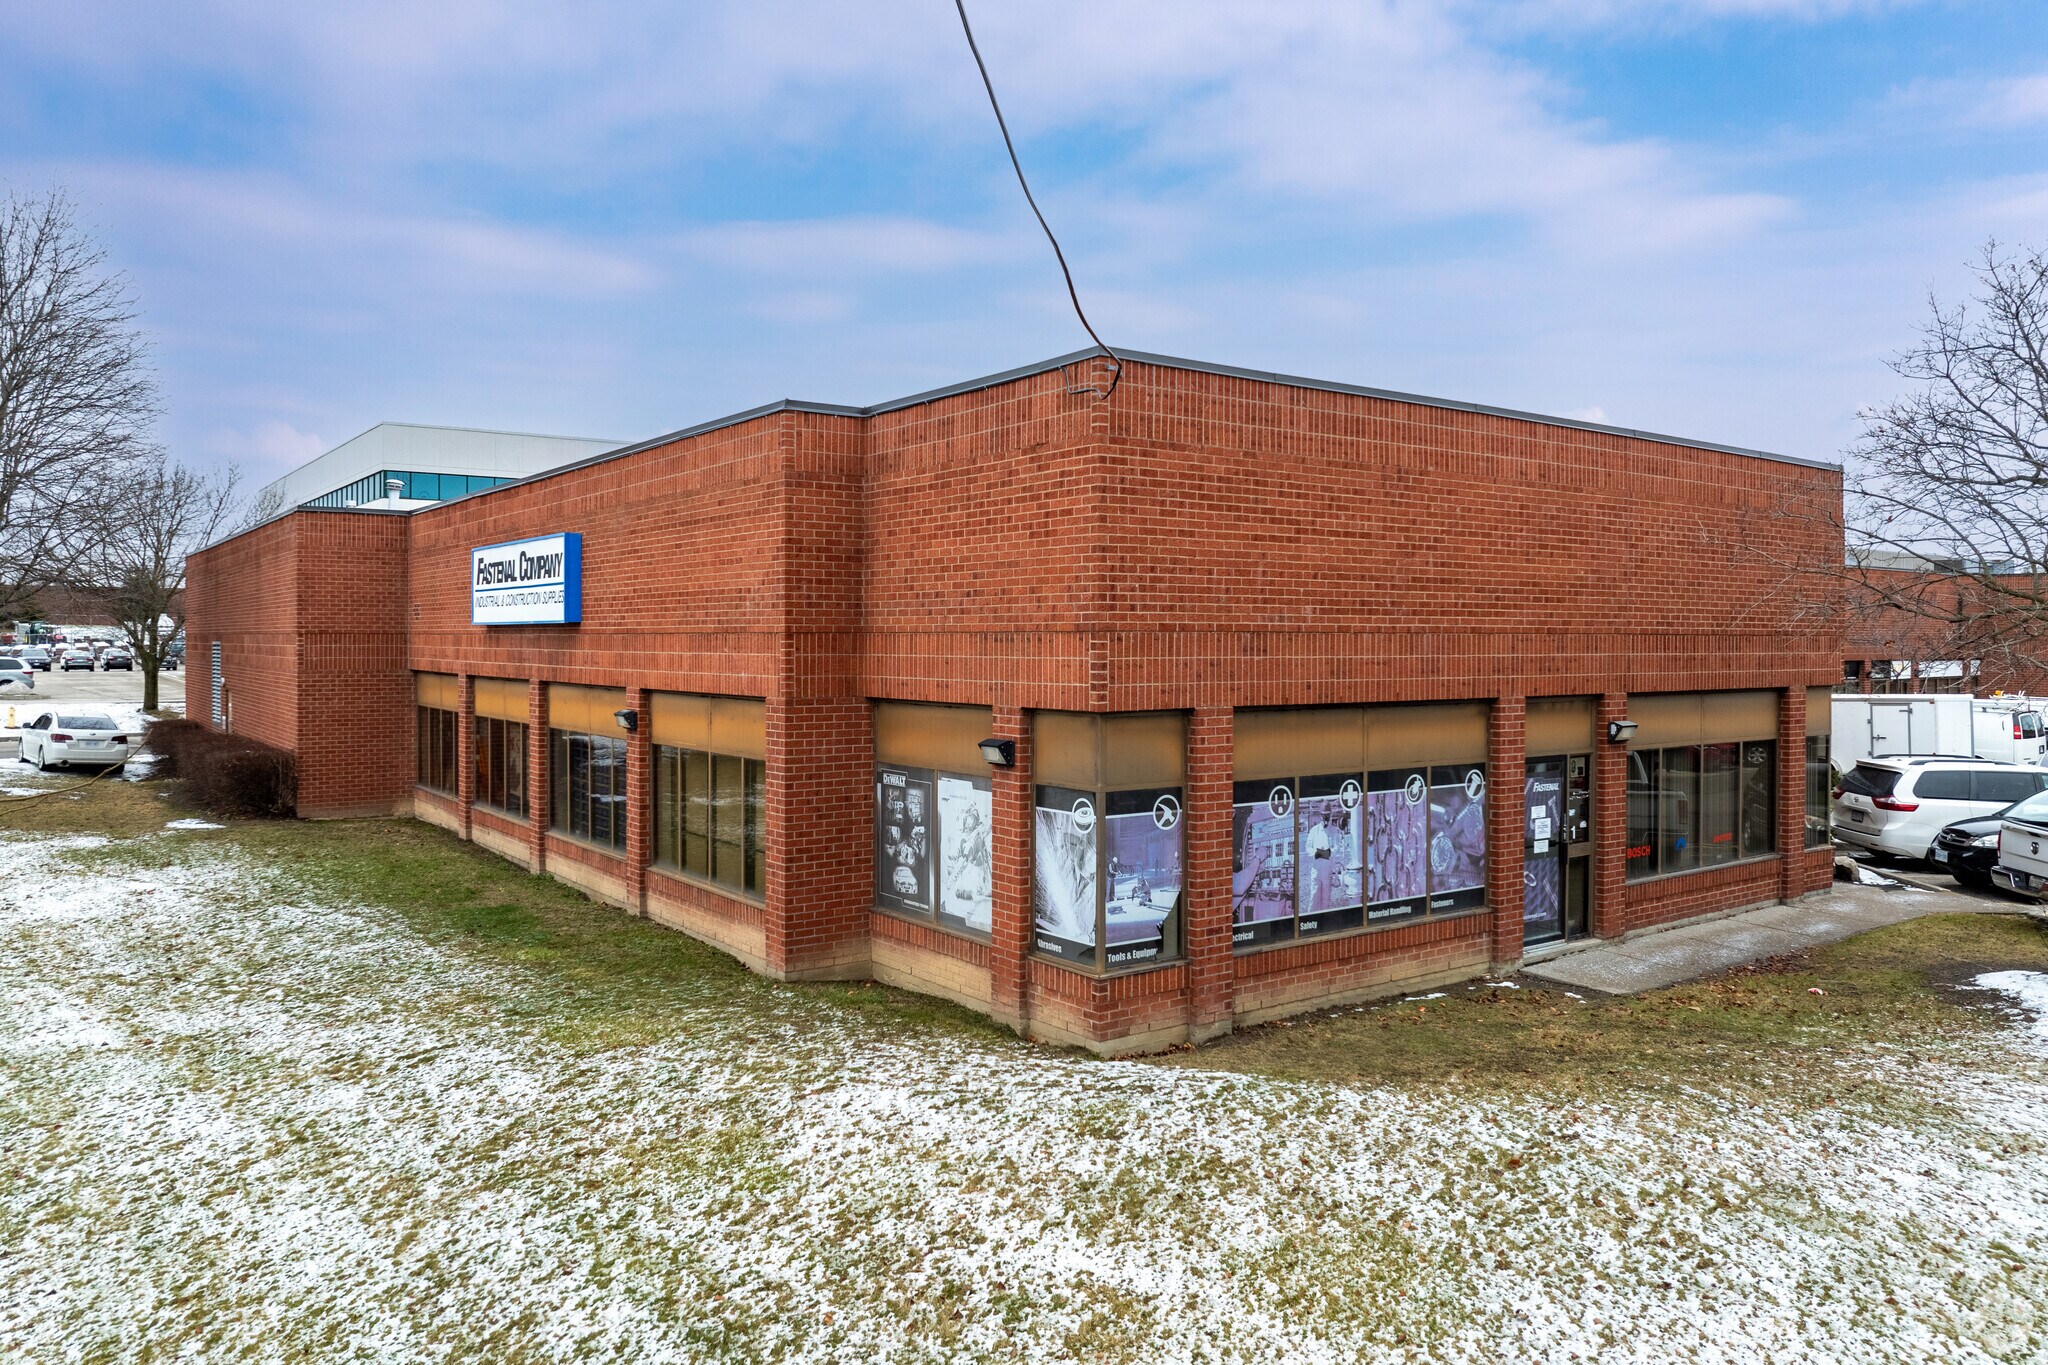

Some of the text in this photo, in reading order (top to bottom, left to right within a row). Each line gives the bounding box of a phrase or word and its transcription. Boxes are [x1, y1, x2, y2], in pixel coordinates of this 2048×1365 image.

[476, 551, 563, 585] FASTENAL COMPANY
[475, 595, 500, 607] INDUSTRIAL
[505, 591, 541, 607] CONSTRUCTION
[1627, 845, 1651, 859] BOSCH
[1300, 921, 1318, 931] Safety
[1037, 939, 1062, 953] Abrasives
[1107, 952, 1126, 963] Tools
[1126, 951, 1132, 960] &
